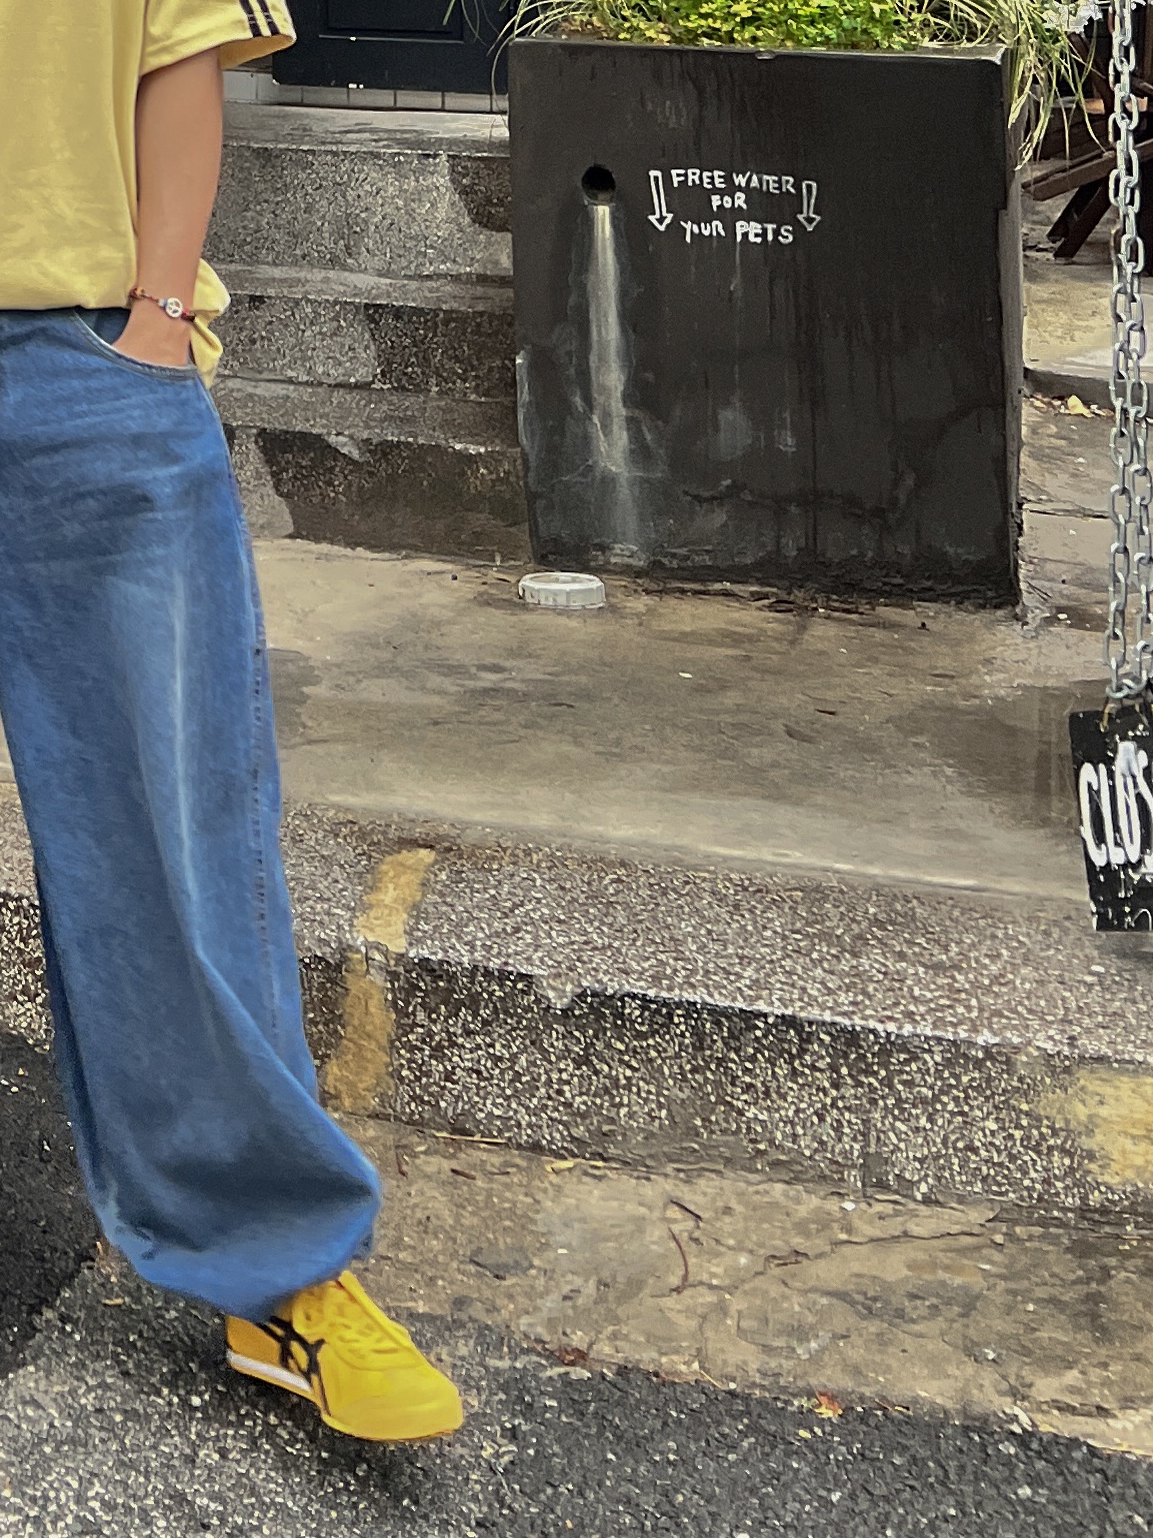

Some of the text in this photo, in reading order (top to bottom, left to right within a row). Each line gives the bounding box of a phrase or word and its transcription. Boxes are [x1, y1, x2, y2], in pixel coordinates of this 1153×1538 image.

[670, 168, 797, 195] FREE WATER
[710, 191, 748, 213] FOR
[734, 219, 794, 245] PETS
